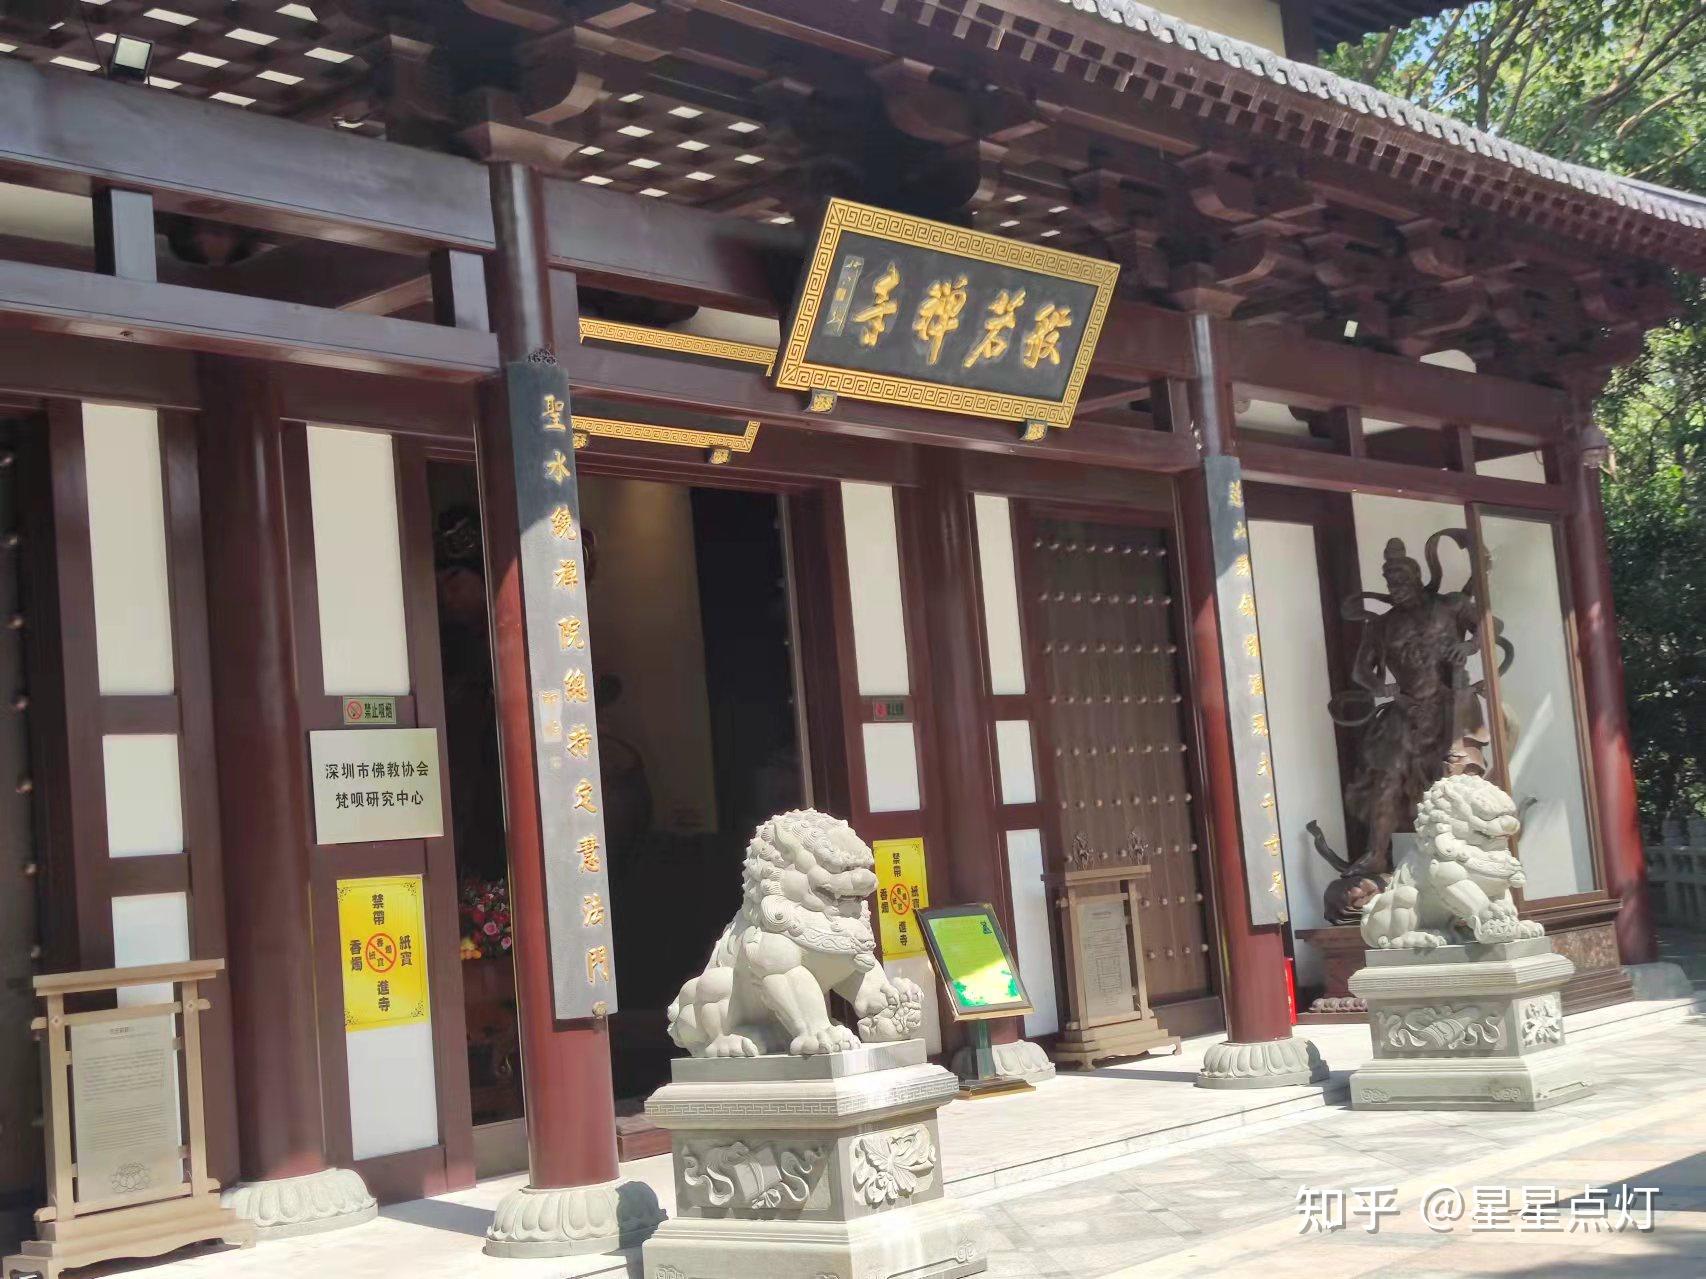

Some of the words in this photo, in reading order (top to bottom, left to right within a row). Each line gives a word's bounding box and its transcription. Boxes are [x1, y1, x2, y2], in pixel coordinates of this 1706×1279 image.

[325, 761, 430, 780] 深圳市佛教协会
[335, 790, 425, 810] 梵呗研究中心
